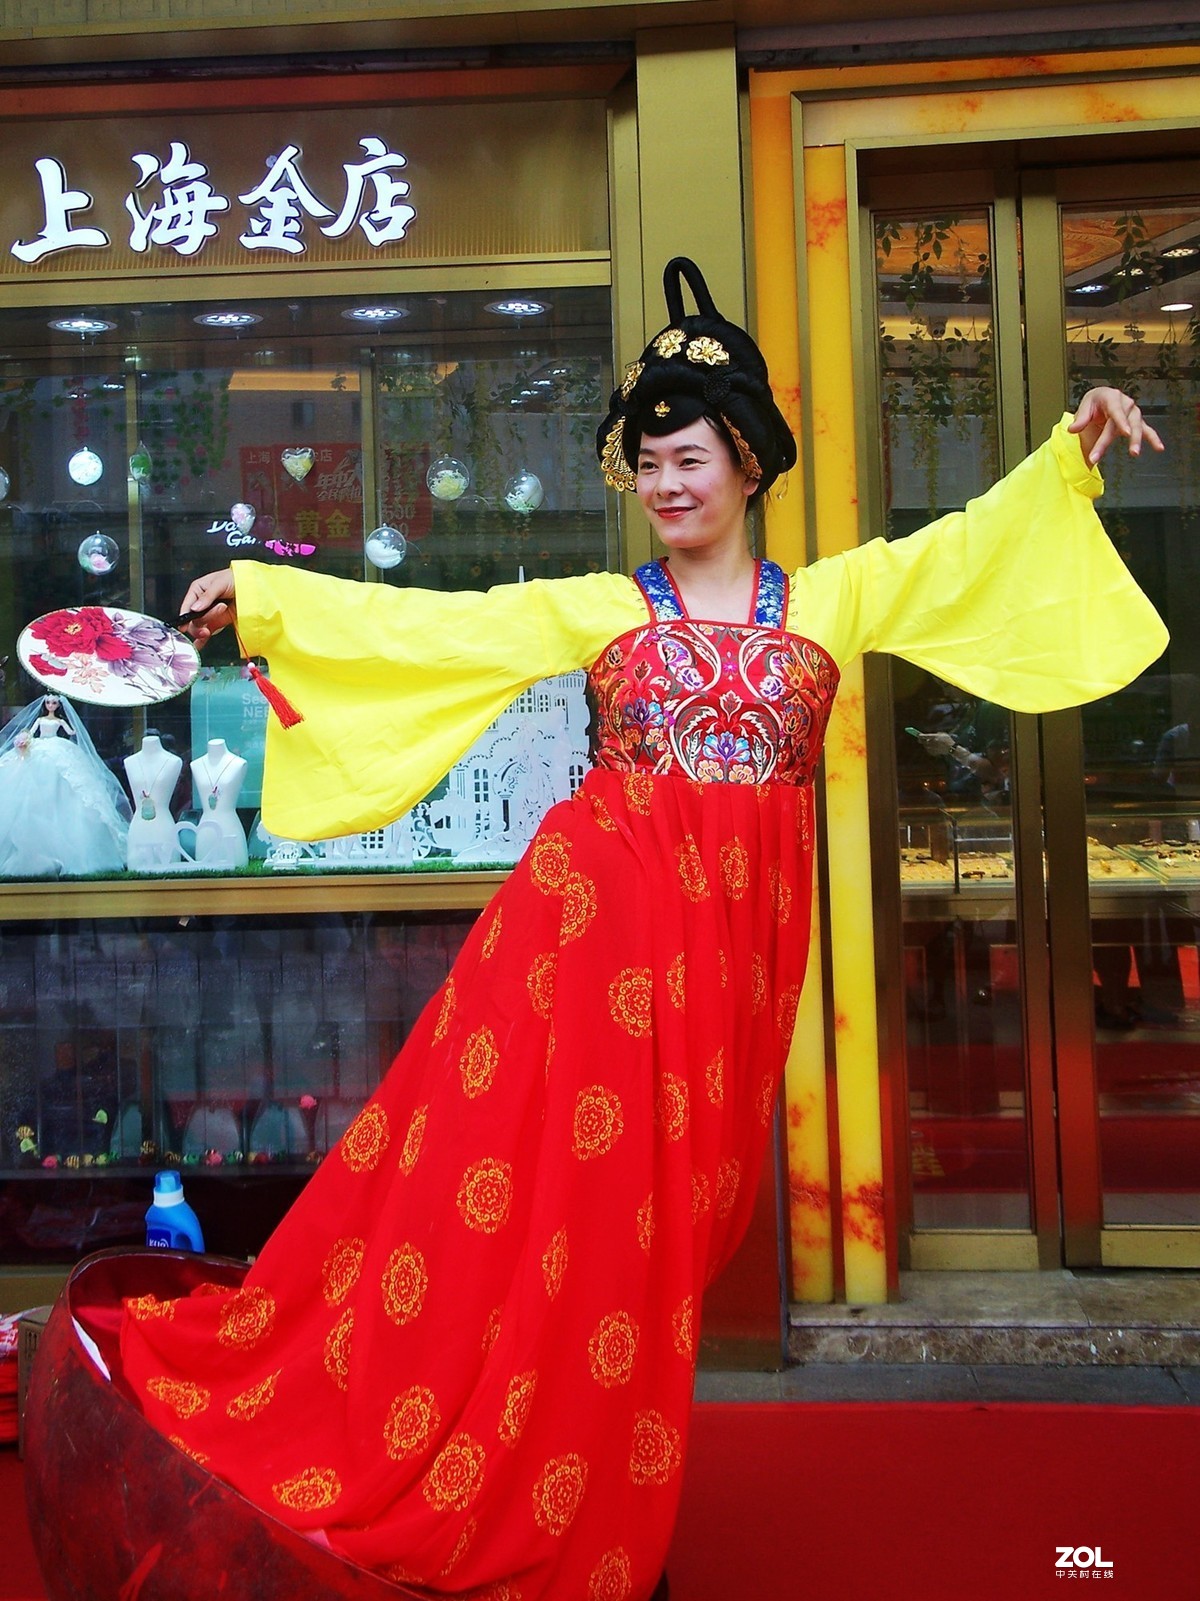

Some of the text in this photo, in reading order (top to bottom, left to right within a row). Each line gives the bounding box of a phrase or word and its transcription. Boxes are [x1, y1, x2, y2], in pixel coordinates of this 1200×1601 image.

[10, 137, 417, 264] 上海金店
[294, 508, 352, 538] 黄金
